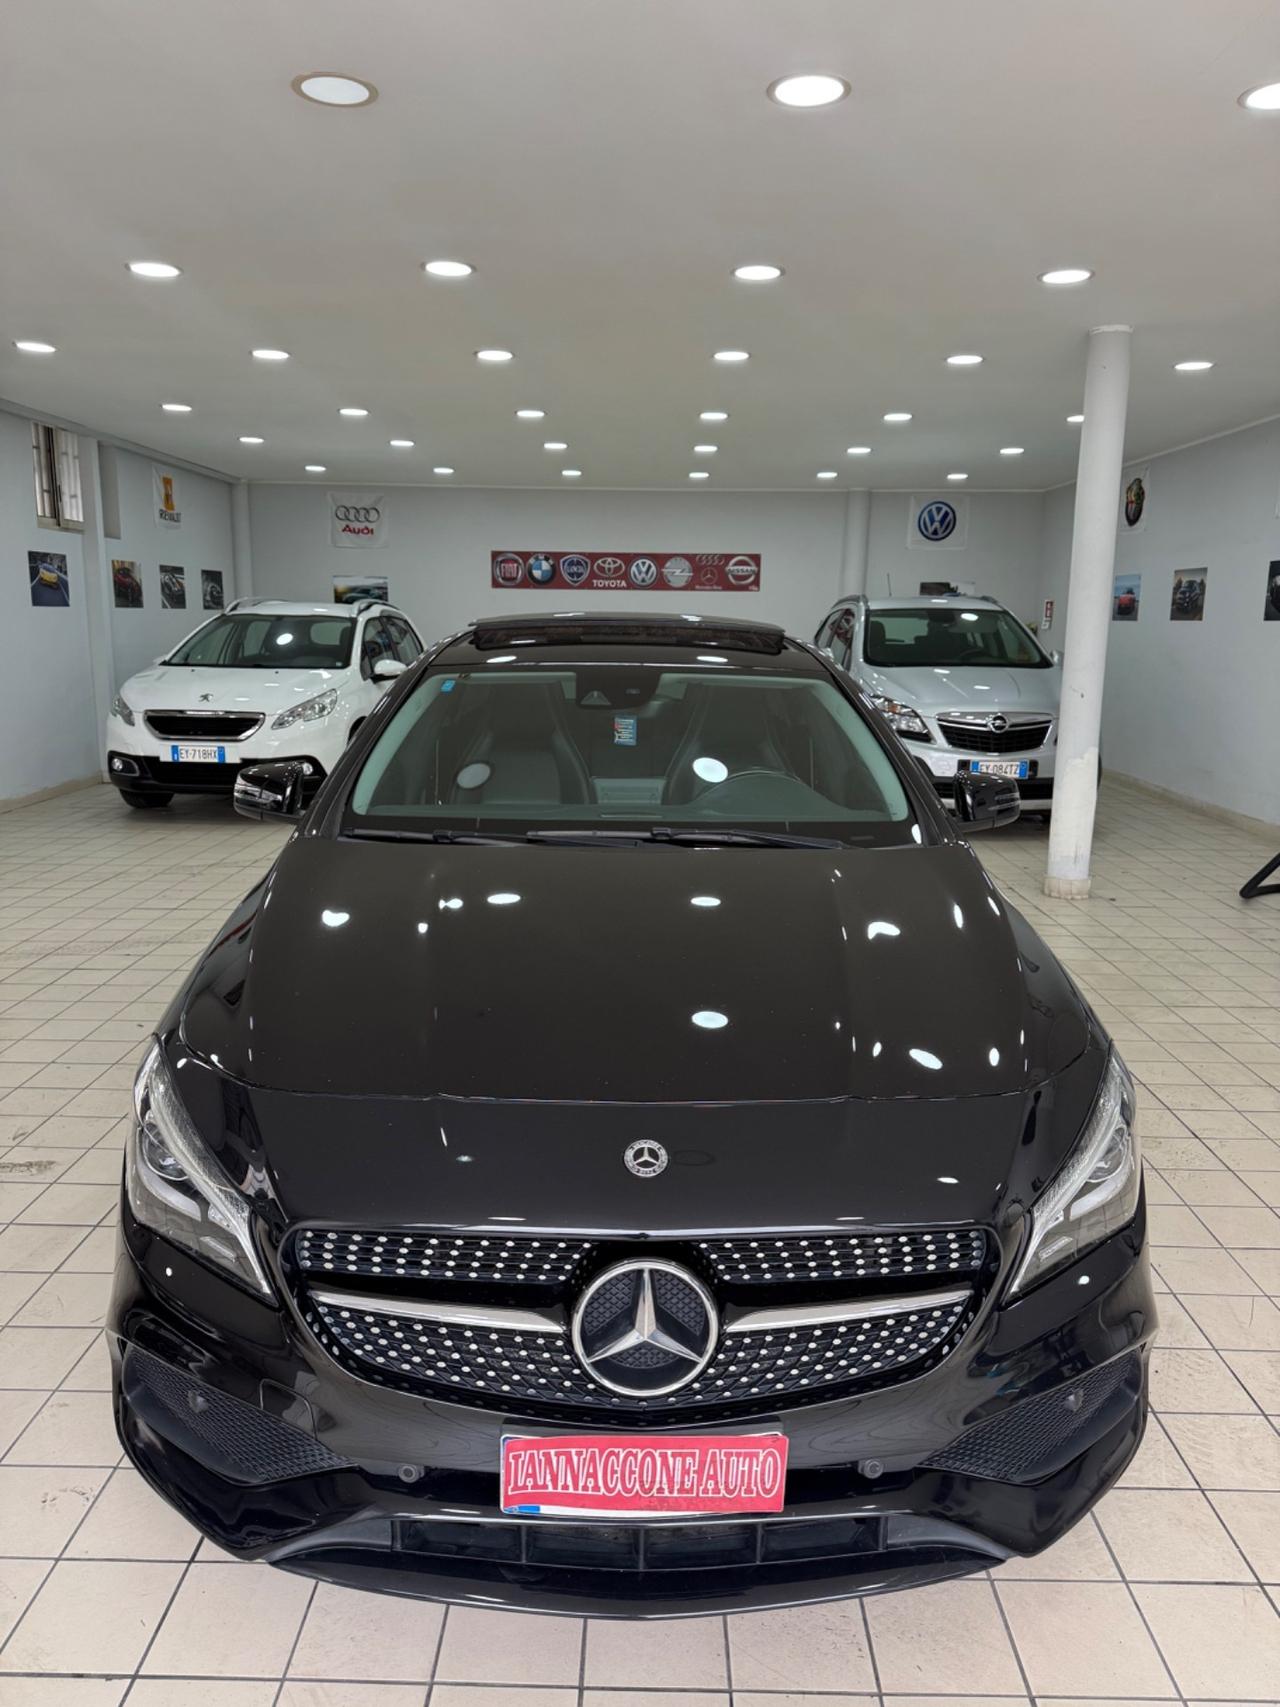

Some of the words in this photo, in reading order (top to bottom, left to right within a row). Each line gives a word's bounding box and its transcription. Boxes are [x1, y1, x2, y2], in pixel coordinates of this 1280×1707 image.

[727, 567, 756, 575] NISSAN
[592, 580, 627, 588] TOYOTA
[508, 1447, 698, 1496] IANNACCONE
[699, 1447, 782, 1498] AUTO
